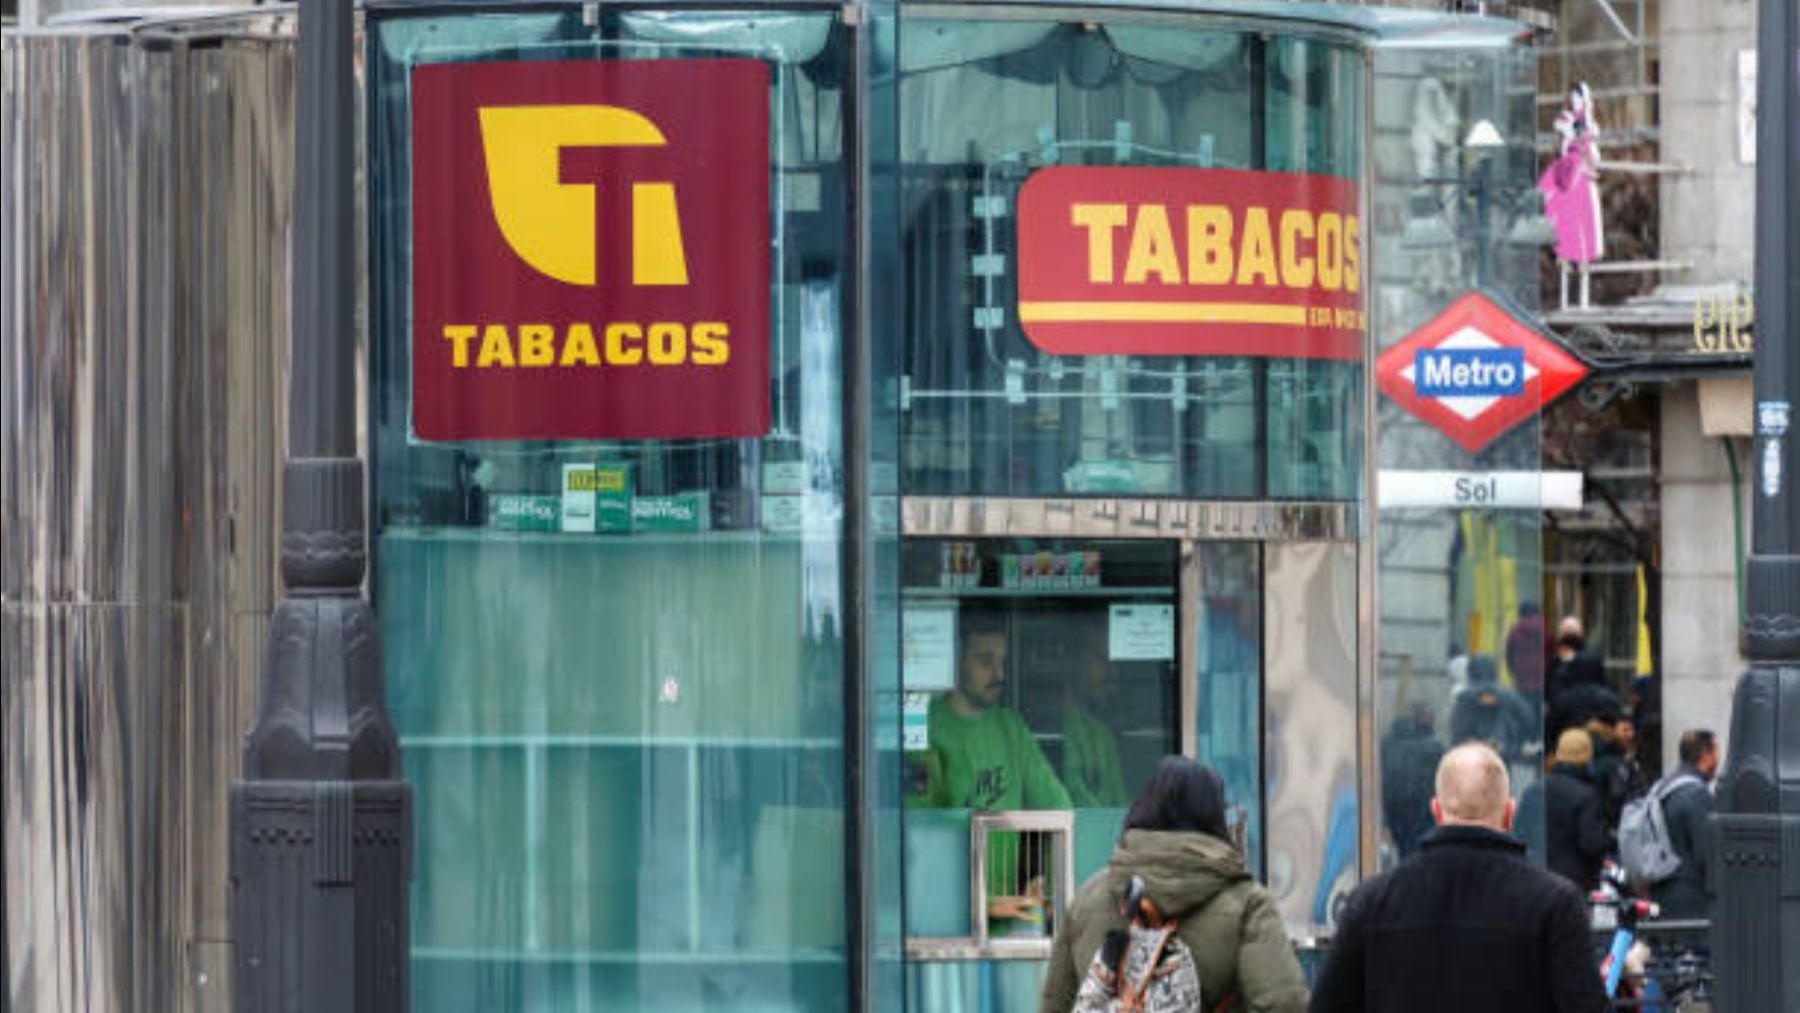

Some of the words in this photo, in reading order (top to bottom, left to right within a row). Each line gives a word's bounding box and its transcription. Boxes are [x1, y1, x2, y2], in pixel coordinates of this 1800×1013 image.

[1070, 203, 1360, 293] TABACOS
[443, 322, 731, 368] TABACOS
[1423, 355, 1517, 388] Metro
[1455, 477, 1496, 503] Sol
